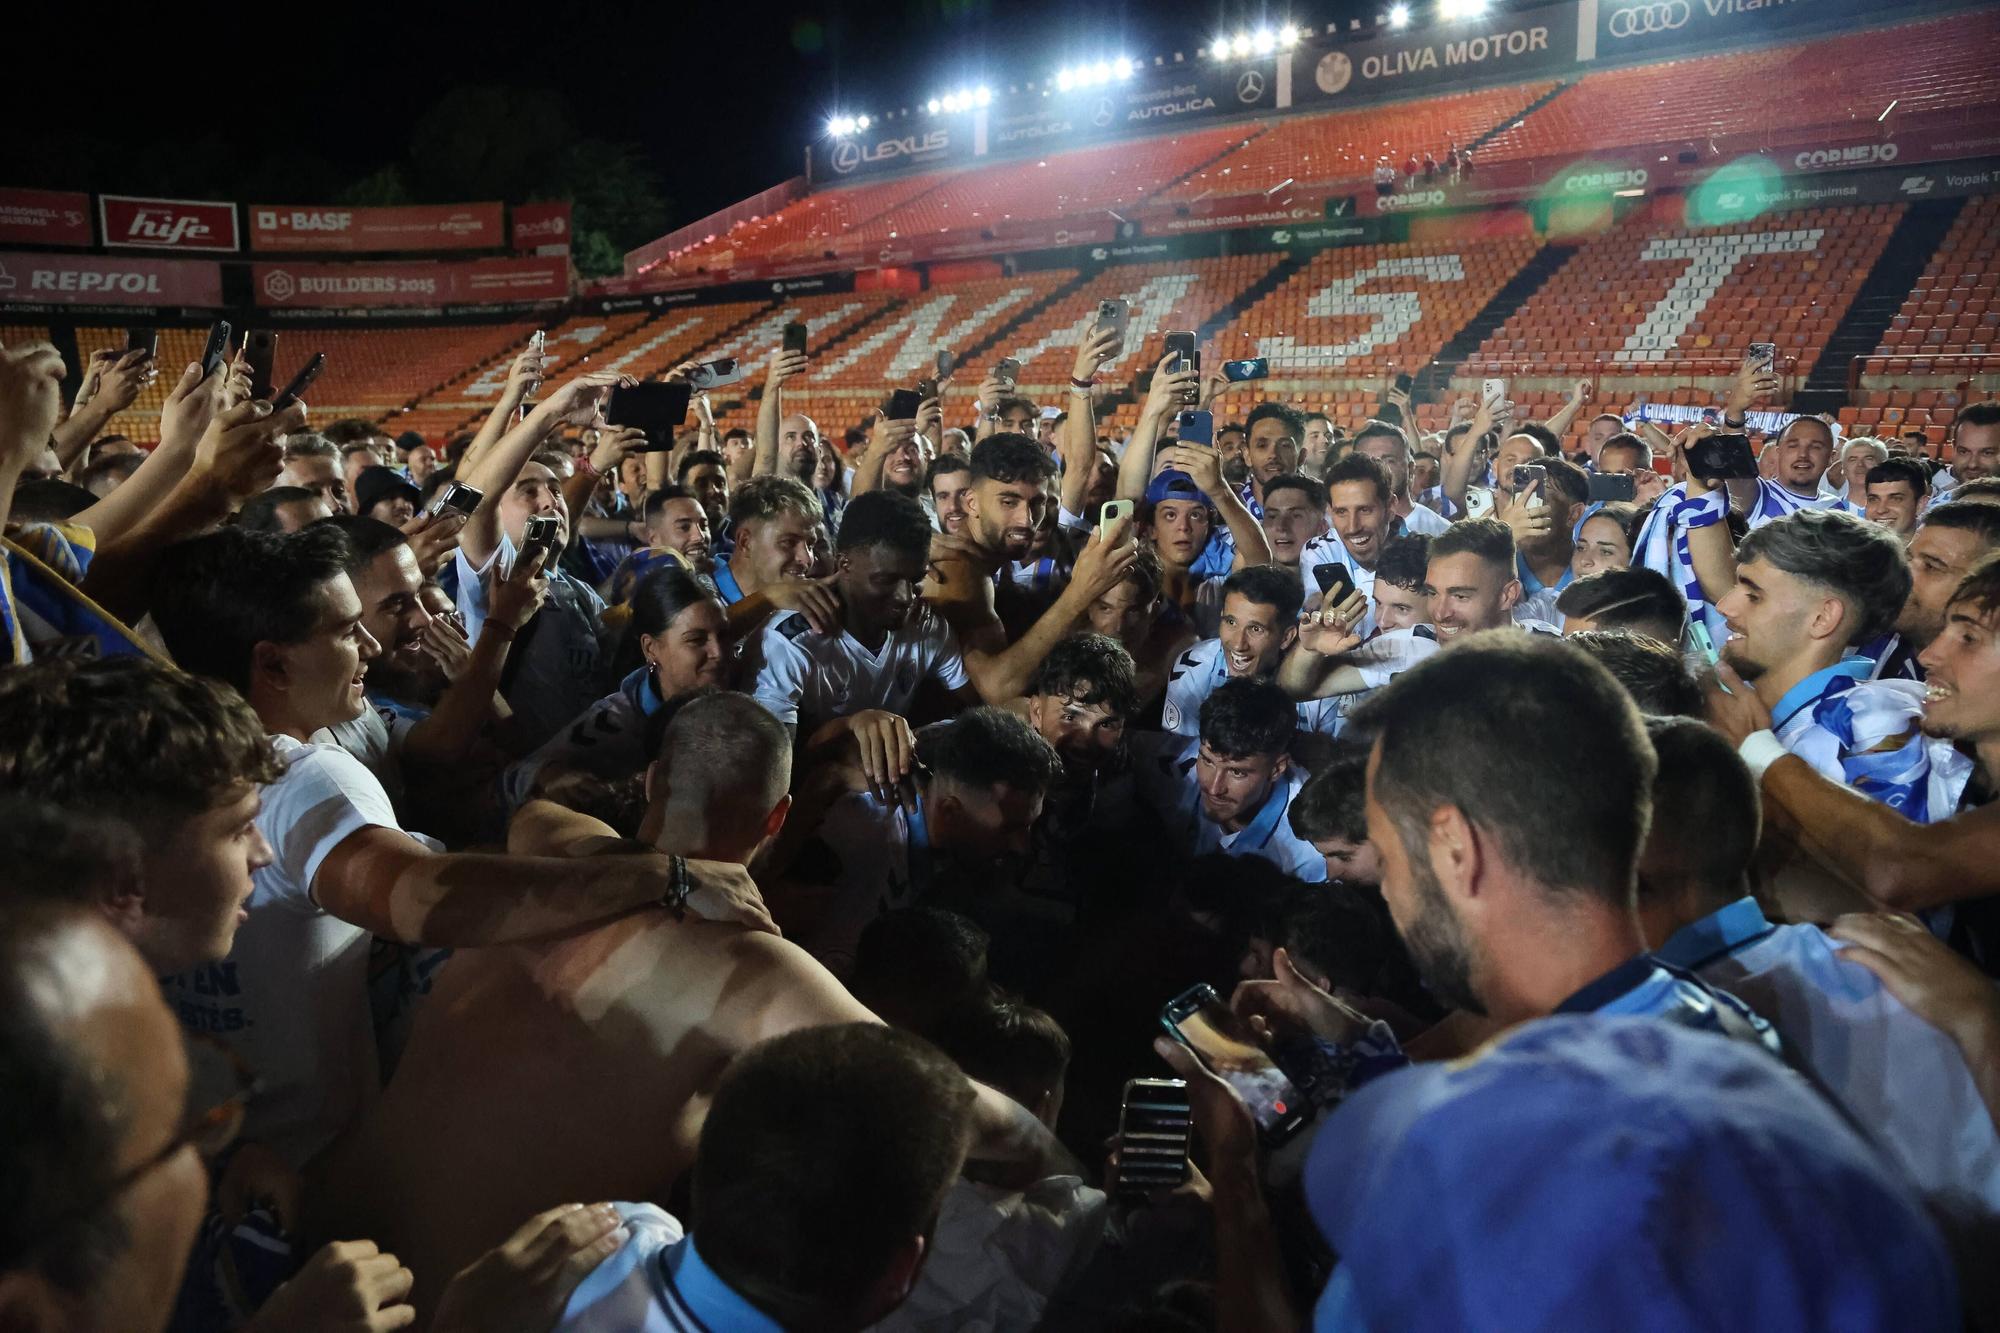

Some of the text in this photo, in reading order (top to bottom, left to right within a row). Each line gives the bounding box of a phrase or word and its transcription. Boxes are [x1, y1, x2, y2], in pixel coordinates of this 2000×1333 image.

[1362, 27, 1548, 79] OLIVA MOTOR
[1128, 97, 1216, 121] AUTOLICA
[862, 129, 949, 162] LEXUS
[1795, 143, 1898, 169] CORNEJO
[1566, 169, 1648, 190] CORNEJO
[1946, 171, 1989, 188] Vopak
[1376, 190, 1445, 209] CORNEJO
[1755, 187, 1857, 205] Vopak Terquimsa
[127, 211, 211, 243] hife
[291, 211, 352, 231] BASF
[1216, 215, 1242, 225] COSTA
[1246, 211, 1288, 222] DAURADA
[32, 269, 161, 293] REPSOL
[299, 276, 397, 294] BUILDERS
